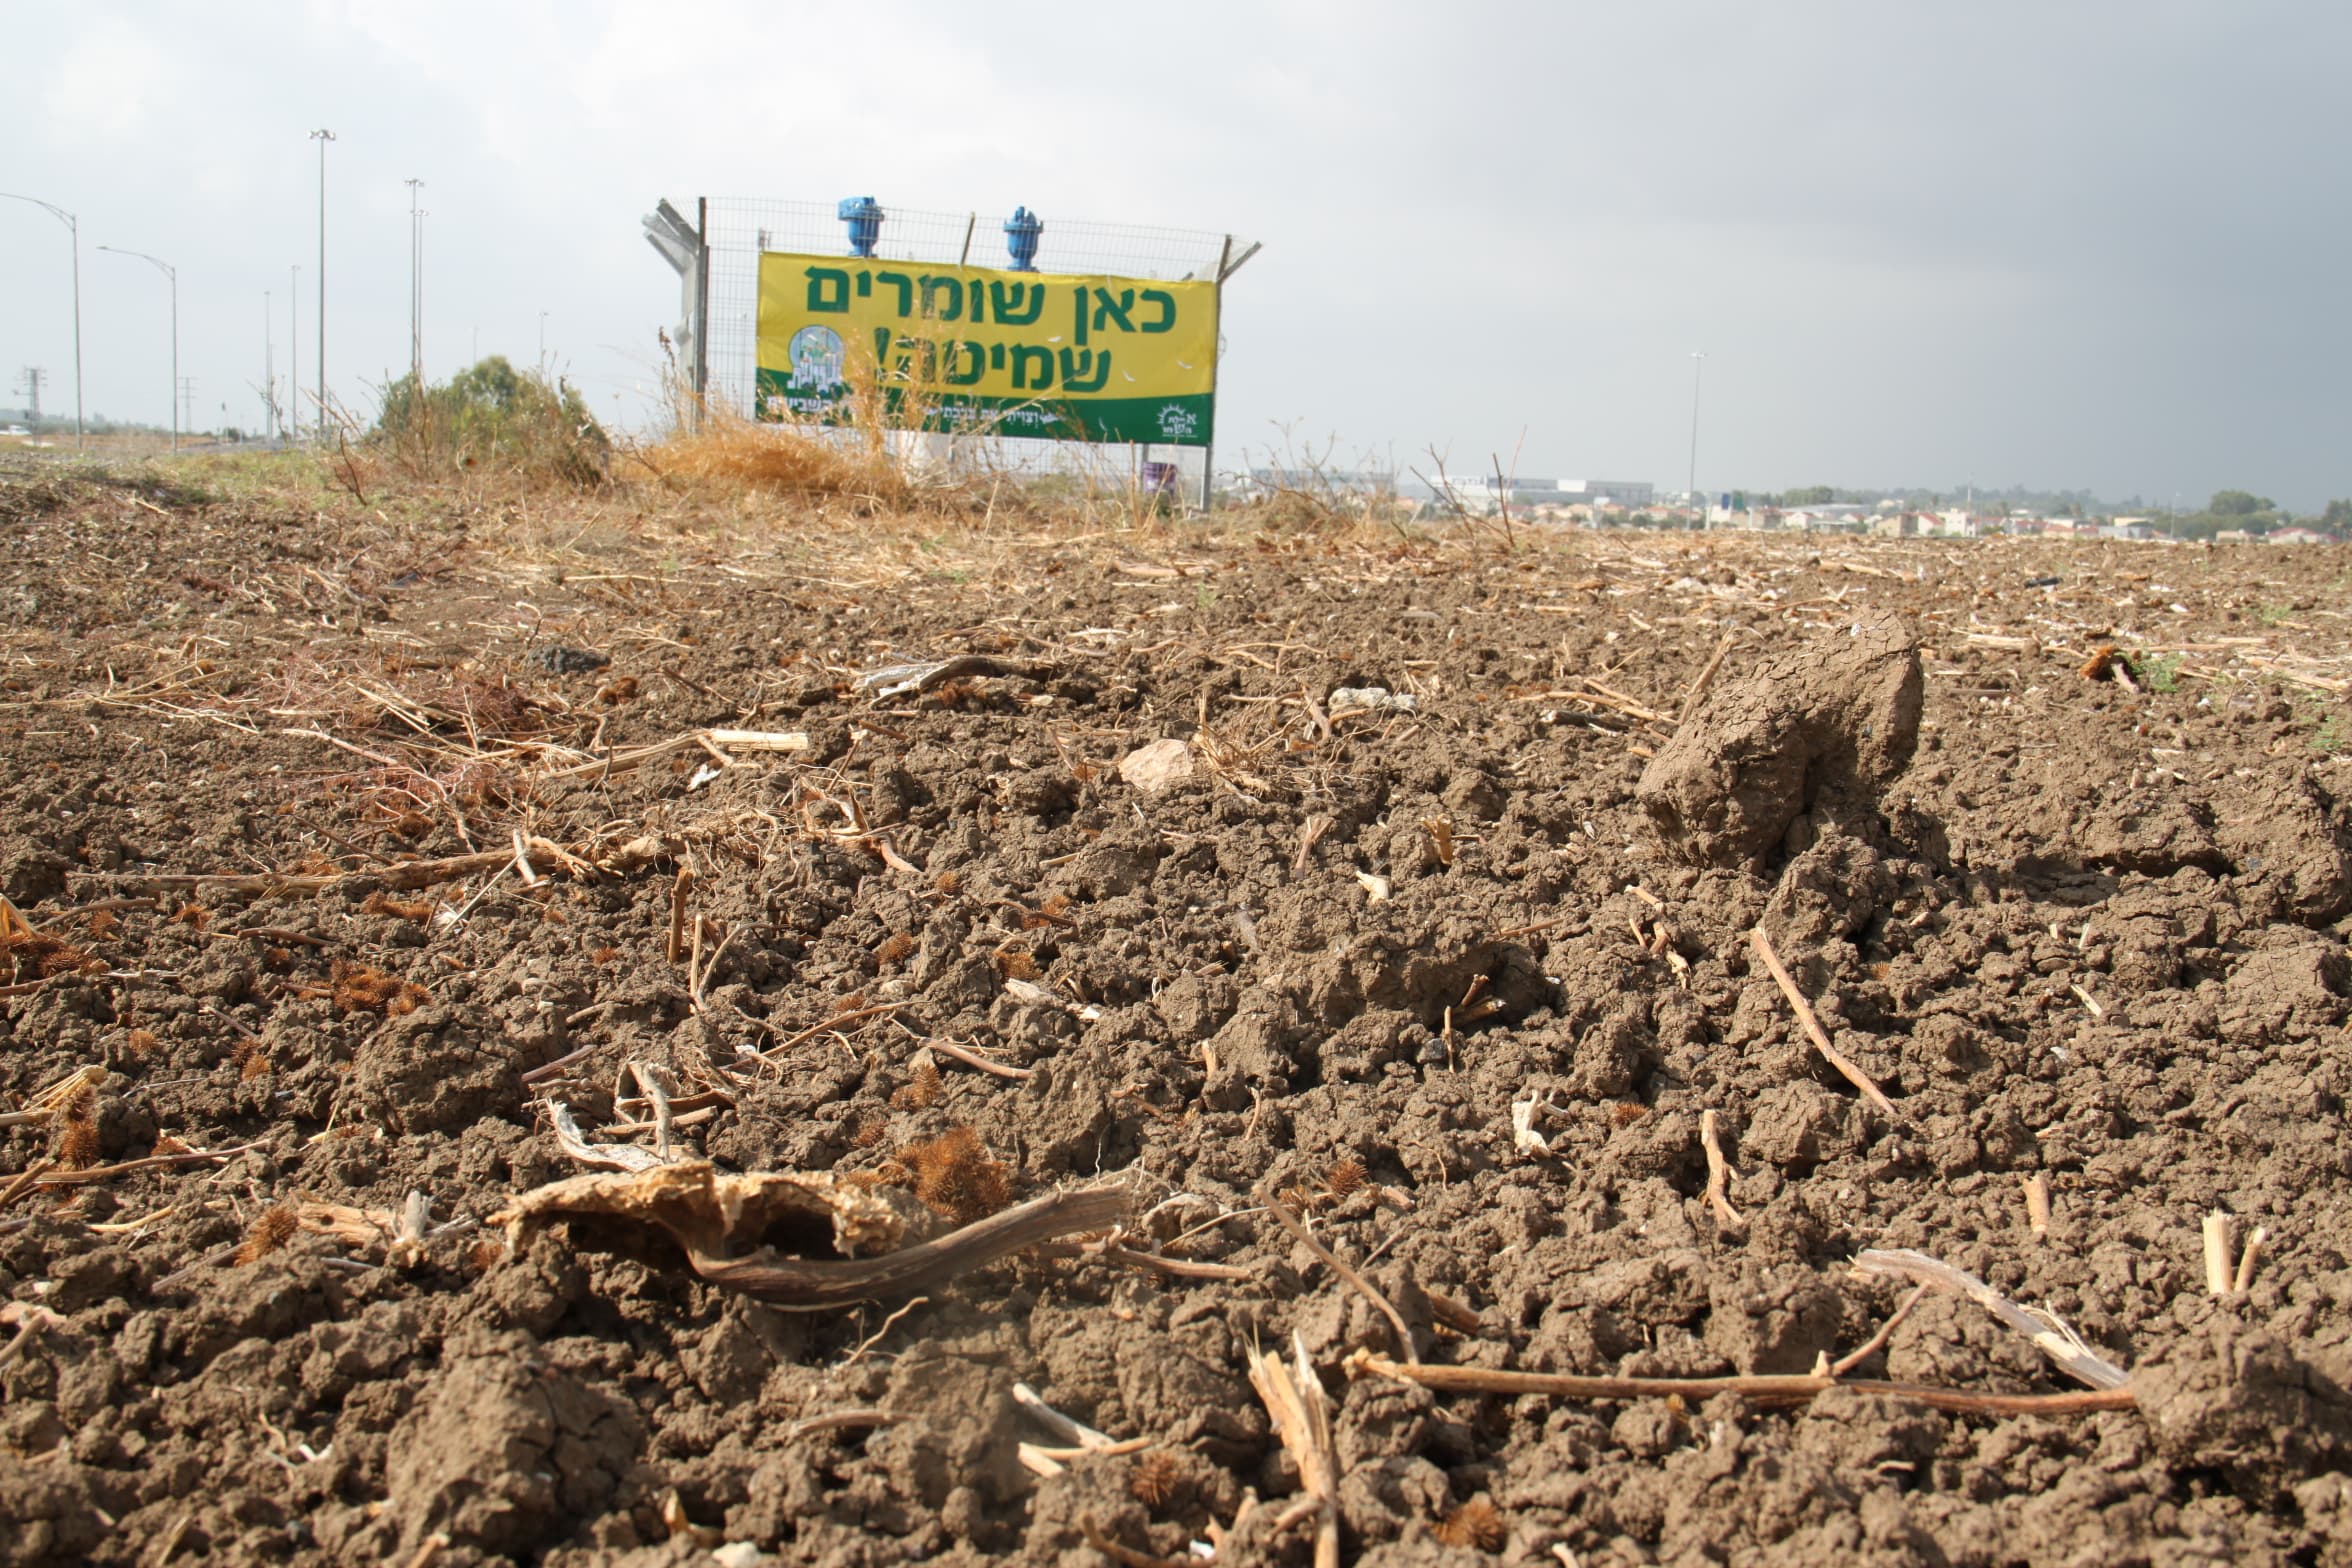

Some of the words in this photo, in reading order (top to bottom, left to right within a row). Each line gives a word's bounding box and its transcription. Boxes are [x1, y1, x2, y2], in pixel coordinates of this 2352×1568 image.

[804, 266, 1046, 326] שומרים
[1073, 285, 1177, 346] כאן
[873, 327, 1112, 393] שמיטה!
